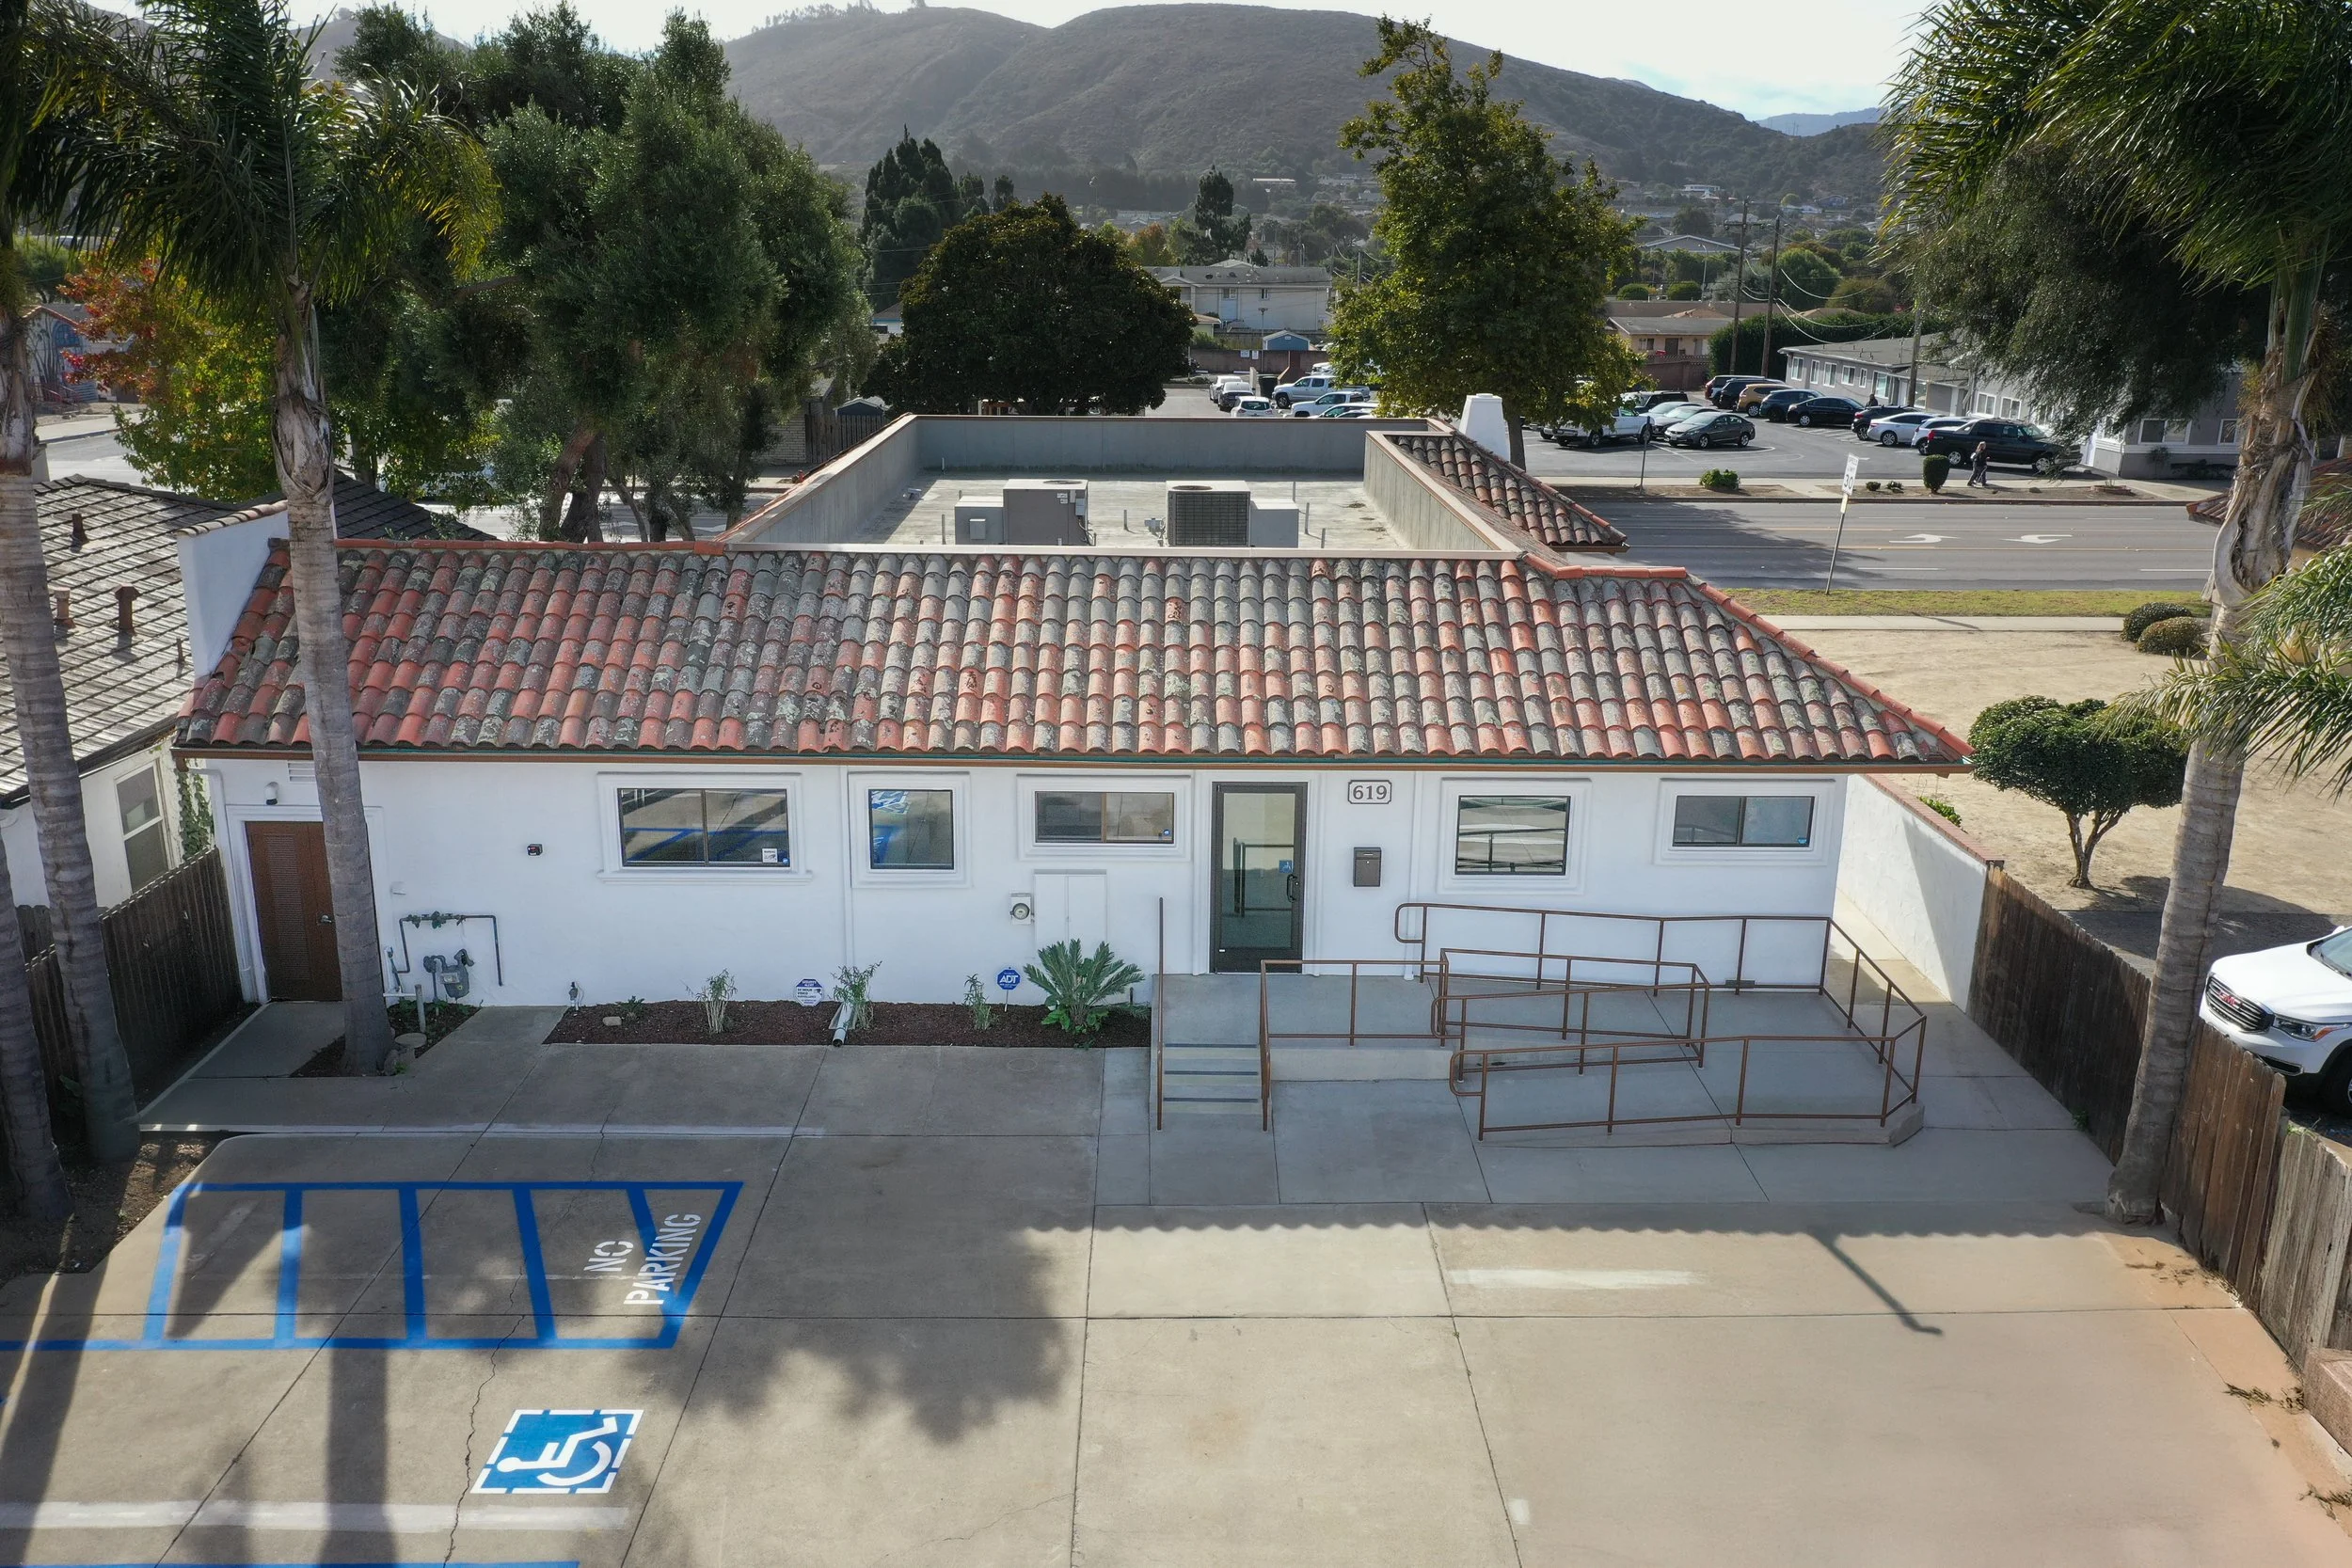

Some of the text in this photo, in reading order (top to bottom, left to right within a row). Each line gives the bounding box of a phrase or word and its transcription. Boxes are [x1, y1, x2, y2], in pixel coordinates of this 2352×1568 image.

[1844, 474, 1853, 489] 30
[1352, 784, 1388, 800] 619
[2218, 991, 2237, 1007] GMC
[583, 1241, 634, 1272] NO
[623, 1213, 702, 1305] PARKING
